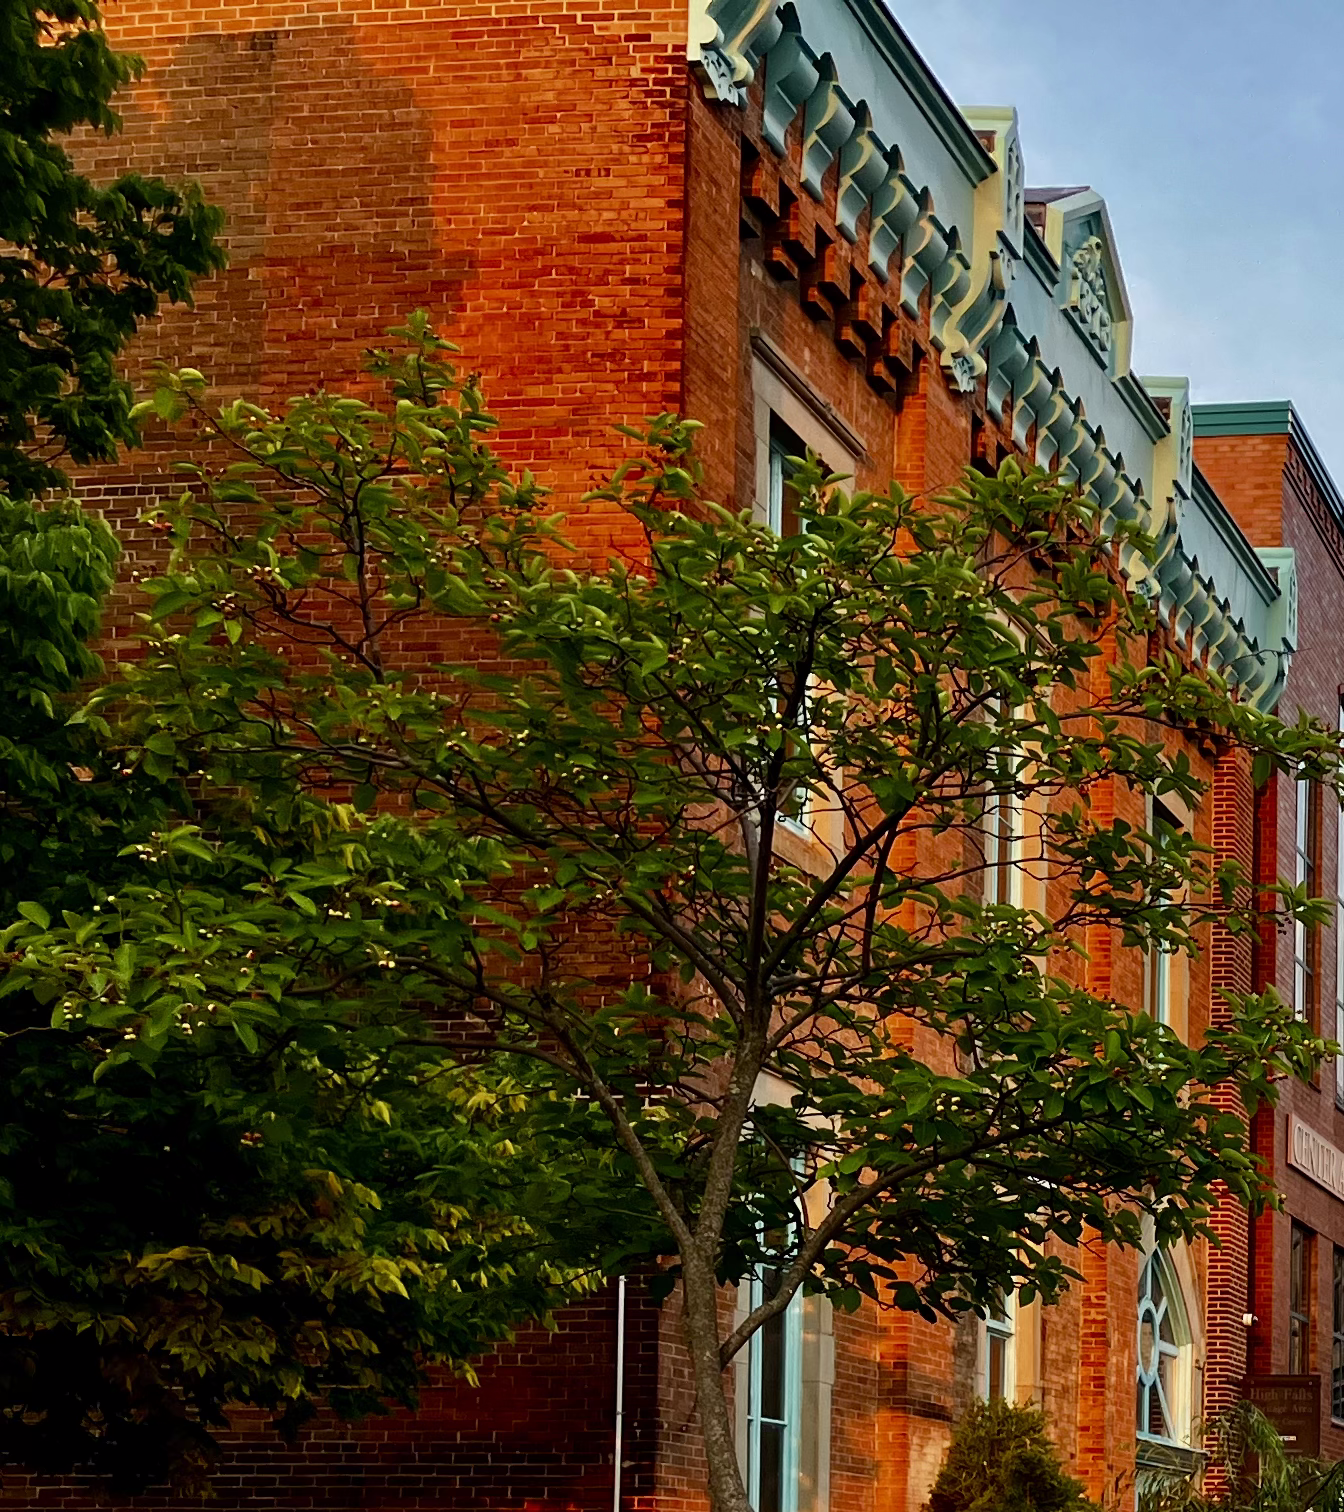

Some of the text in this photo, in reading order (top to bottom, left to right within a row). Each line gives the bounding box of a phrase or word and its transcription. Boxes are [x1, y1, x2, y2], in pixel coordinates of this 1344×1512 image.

[1293, 1123, 1336, 1190] CENTER
[1250, 1387, 1314, 1401] High Falls
